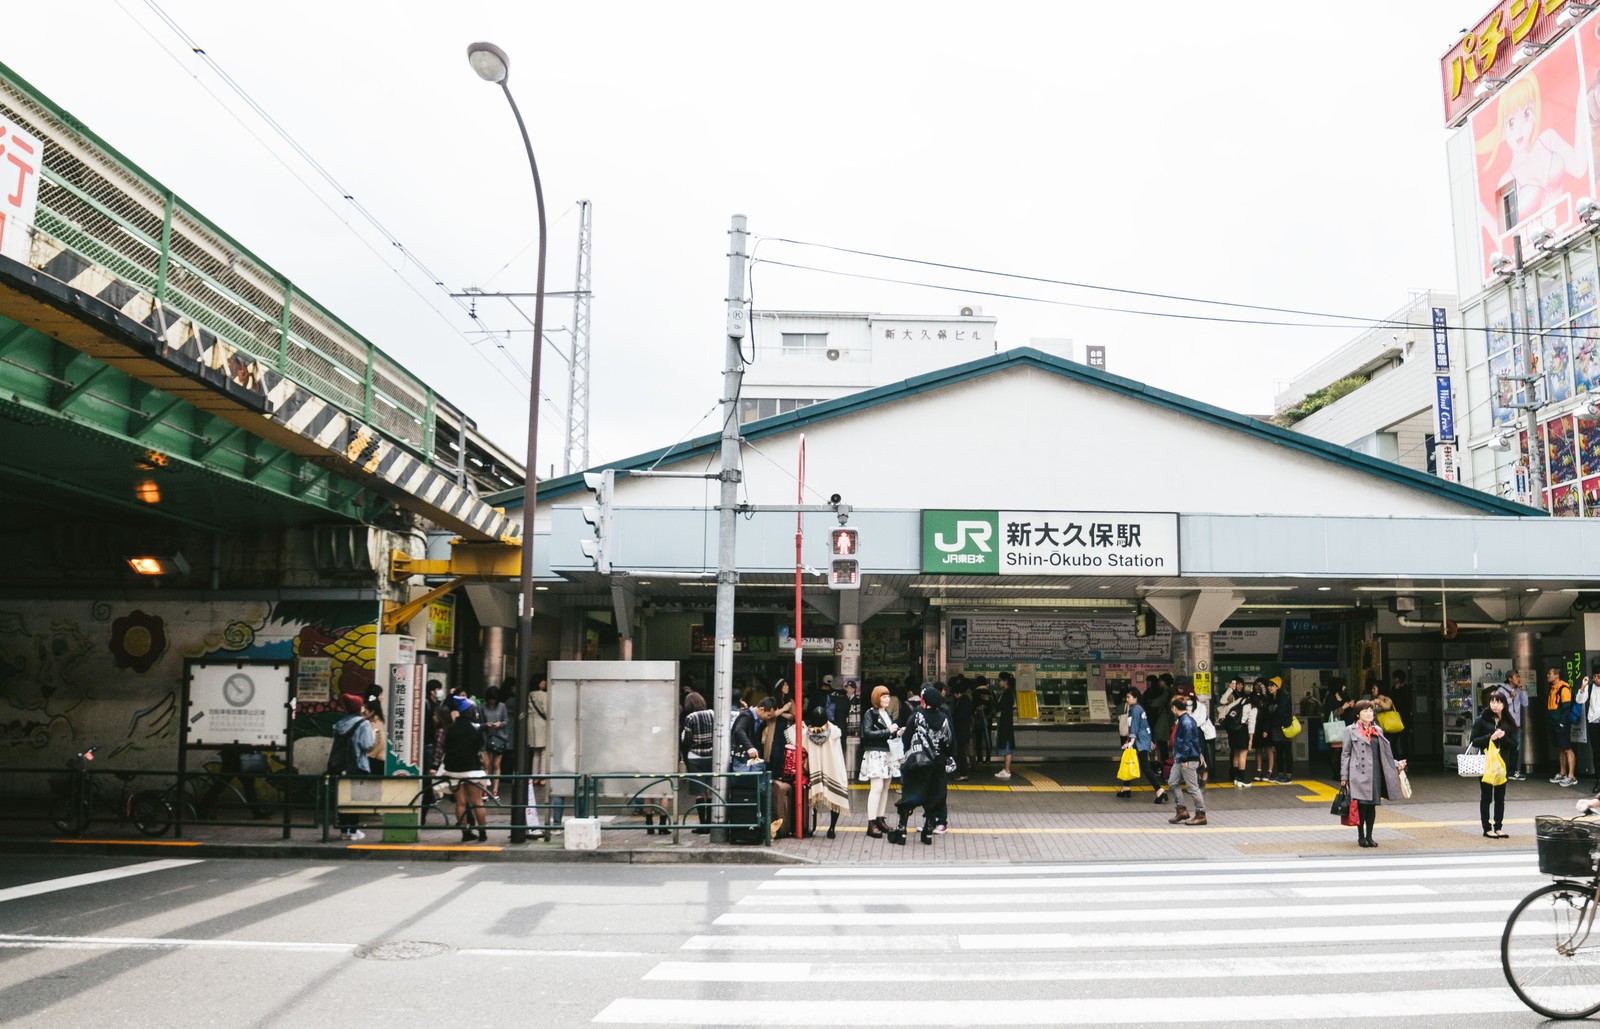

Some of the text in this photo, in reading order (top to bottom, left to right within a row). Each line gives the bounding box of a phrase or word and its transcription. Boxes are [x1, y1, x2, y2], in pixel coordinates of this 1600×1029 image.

[884, 328, 982, 341] 新大久保ビル
[934, 520, 992, 552] JR
[1006, 522, 1142, 548] 新大久保駅
[942, 554, 985, 564] JR東日本
[1108, 553, 1164, 567] Station
